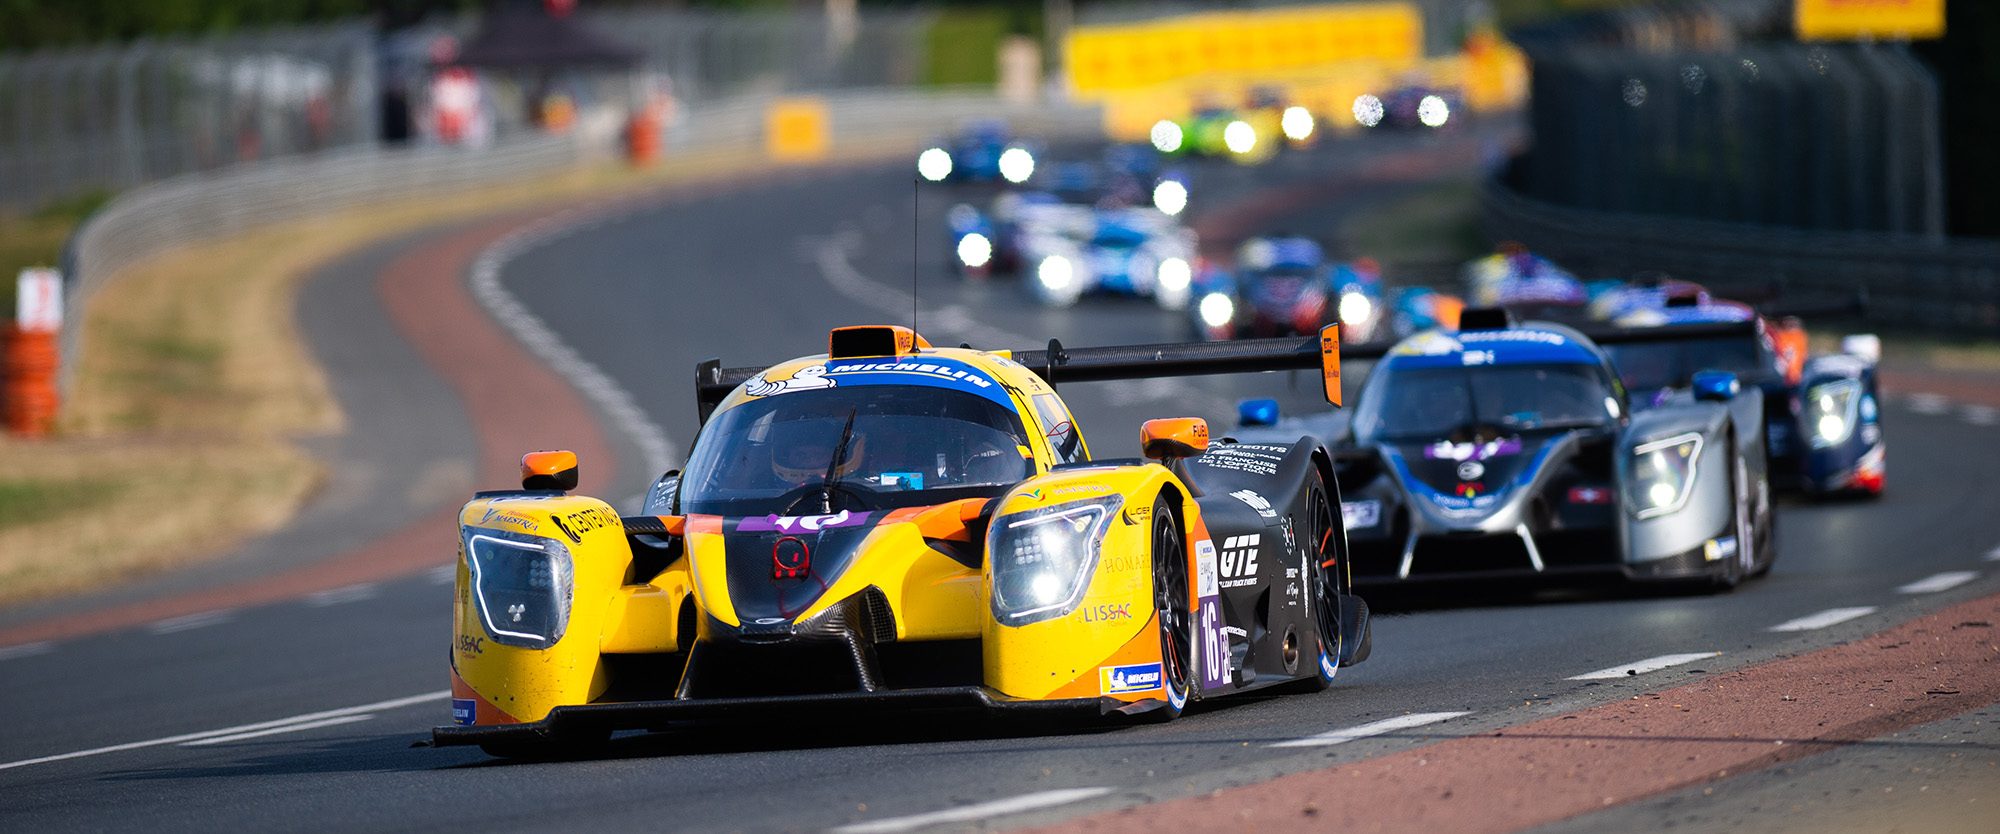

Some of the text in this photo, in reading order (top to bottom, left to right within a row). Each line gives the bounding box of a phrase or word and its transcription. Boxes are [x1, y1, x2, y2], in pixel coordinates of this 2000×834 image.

[831, 363, 992, 388] MICHELIN
[1220, 533, 1260, 578] GTE
[1083, 603, 1133, 623] LISSAC
[1202, 601, 1219, 682] 16
[1127, 672, 1159, 684] MICHELIN
